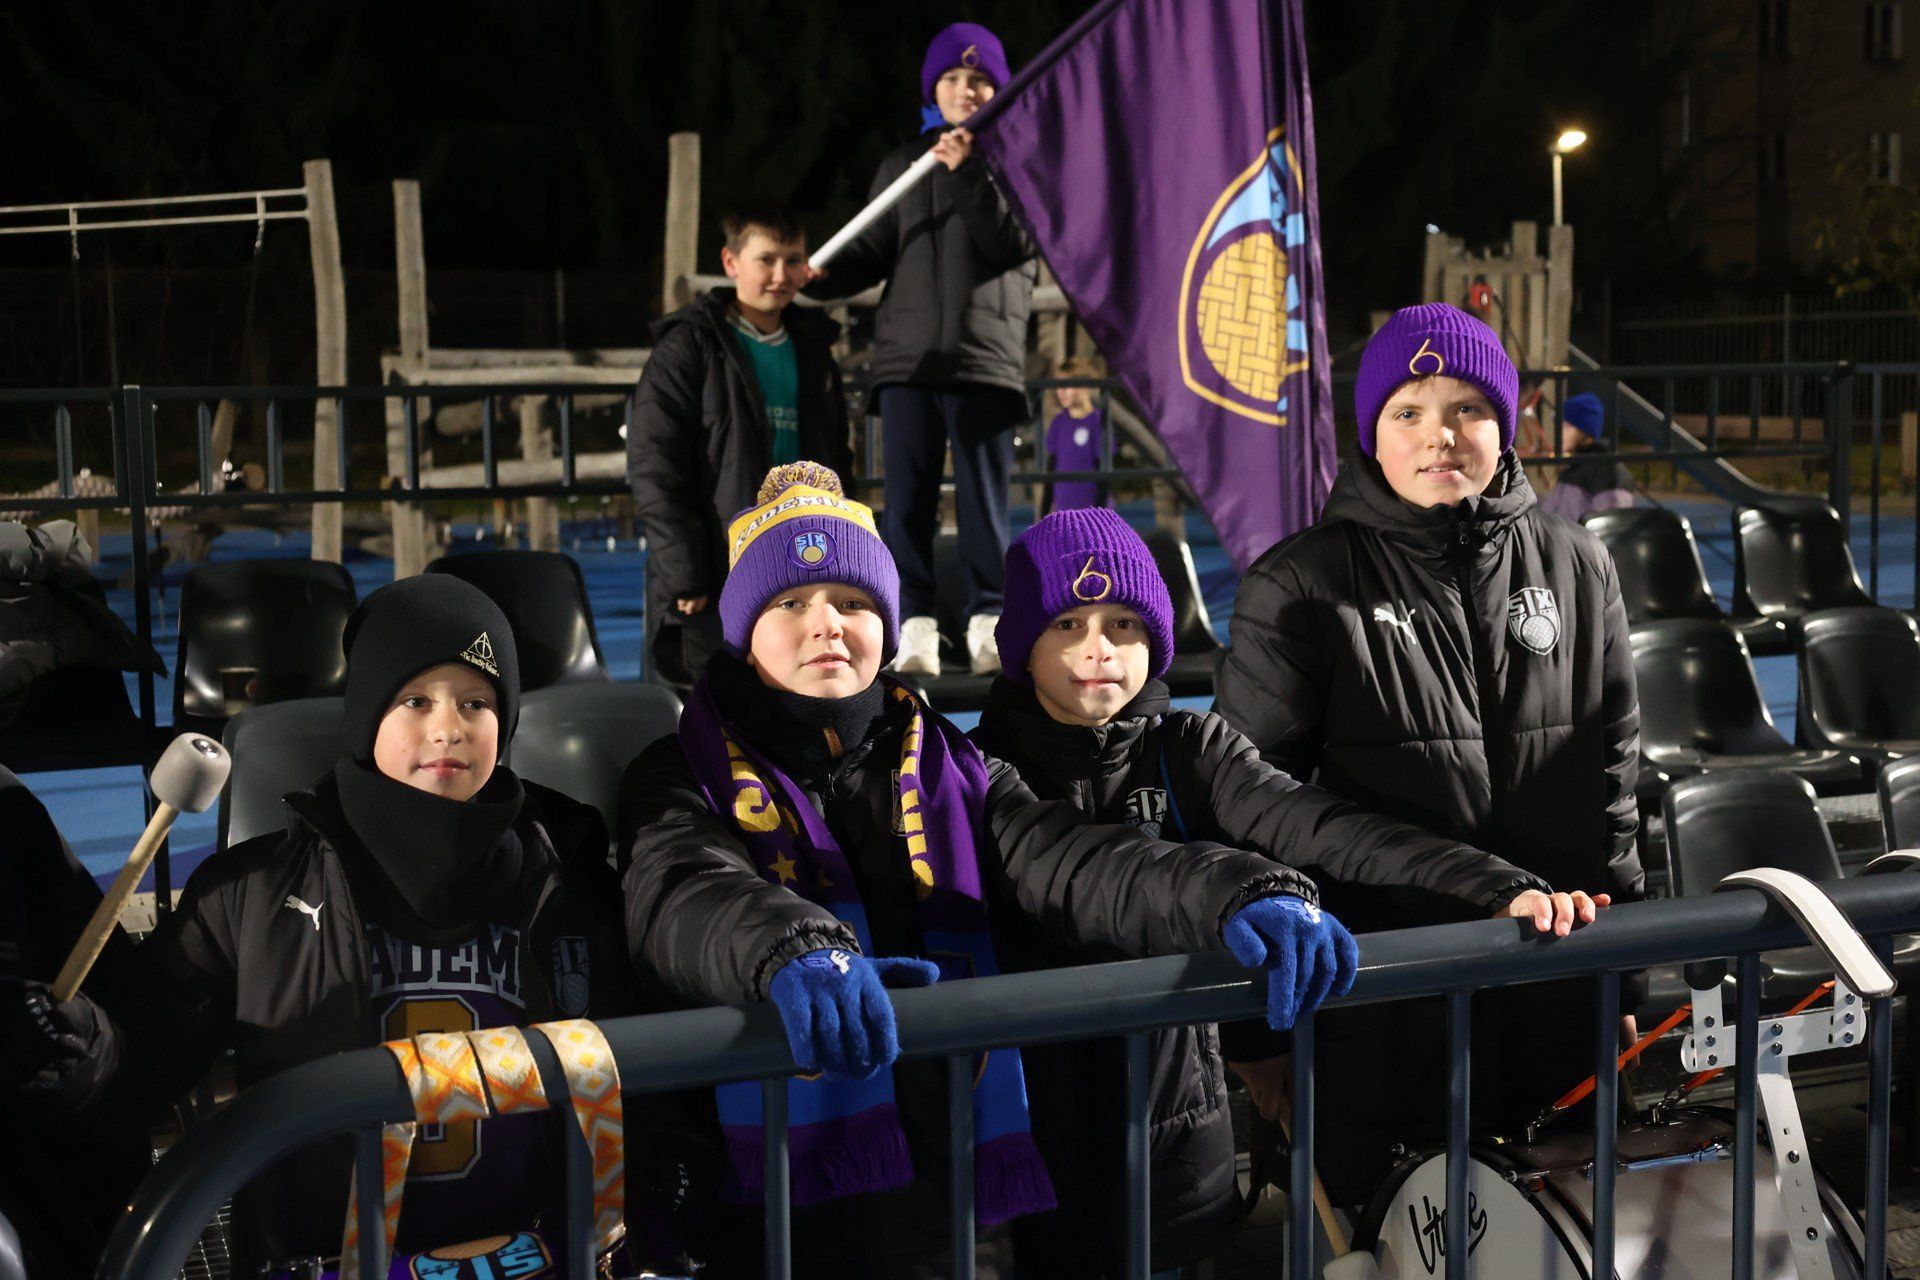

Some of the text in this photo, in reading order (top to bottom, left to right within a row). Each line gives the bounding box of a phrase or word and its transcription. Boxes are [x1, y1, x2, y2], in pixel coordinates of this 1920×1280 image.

[961, 45, 979, 68] 6
[1409, 338, 1444, 375] 6
[796, 532, 825, 547] SIX
[1072, 555, 1112, 601] 6
[1508, 589, 1555, 617] SIX
[371, 922, 525, 1008] ADEM
